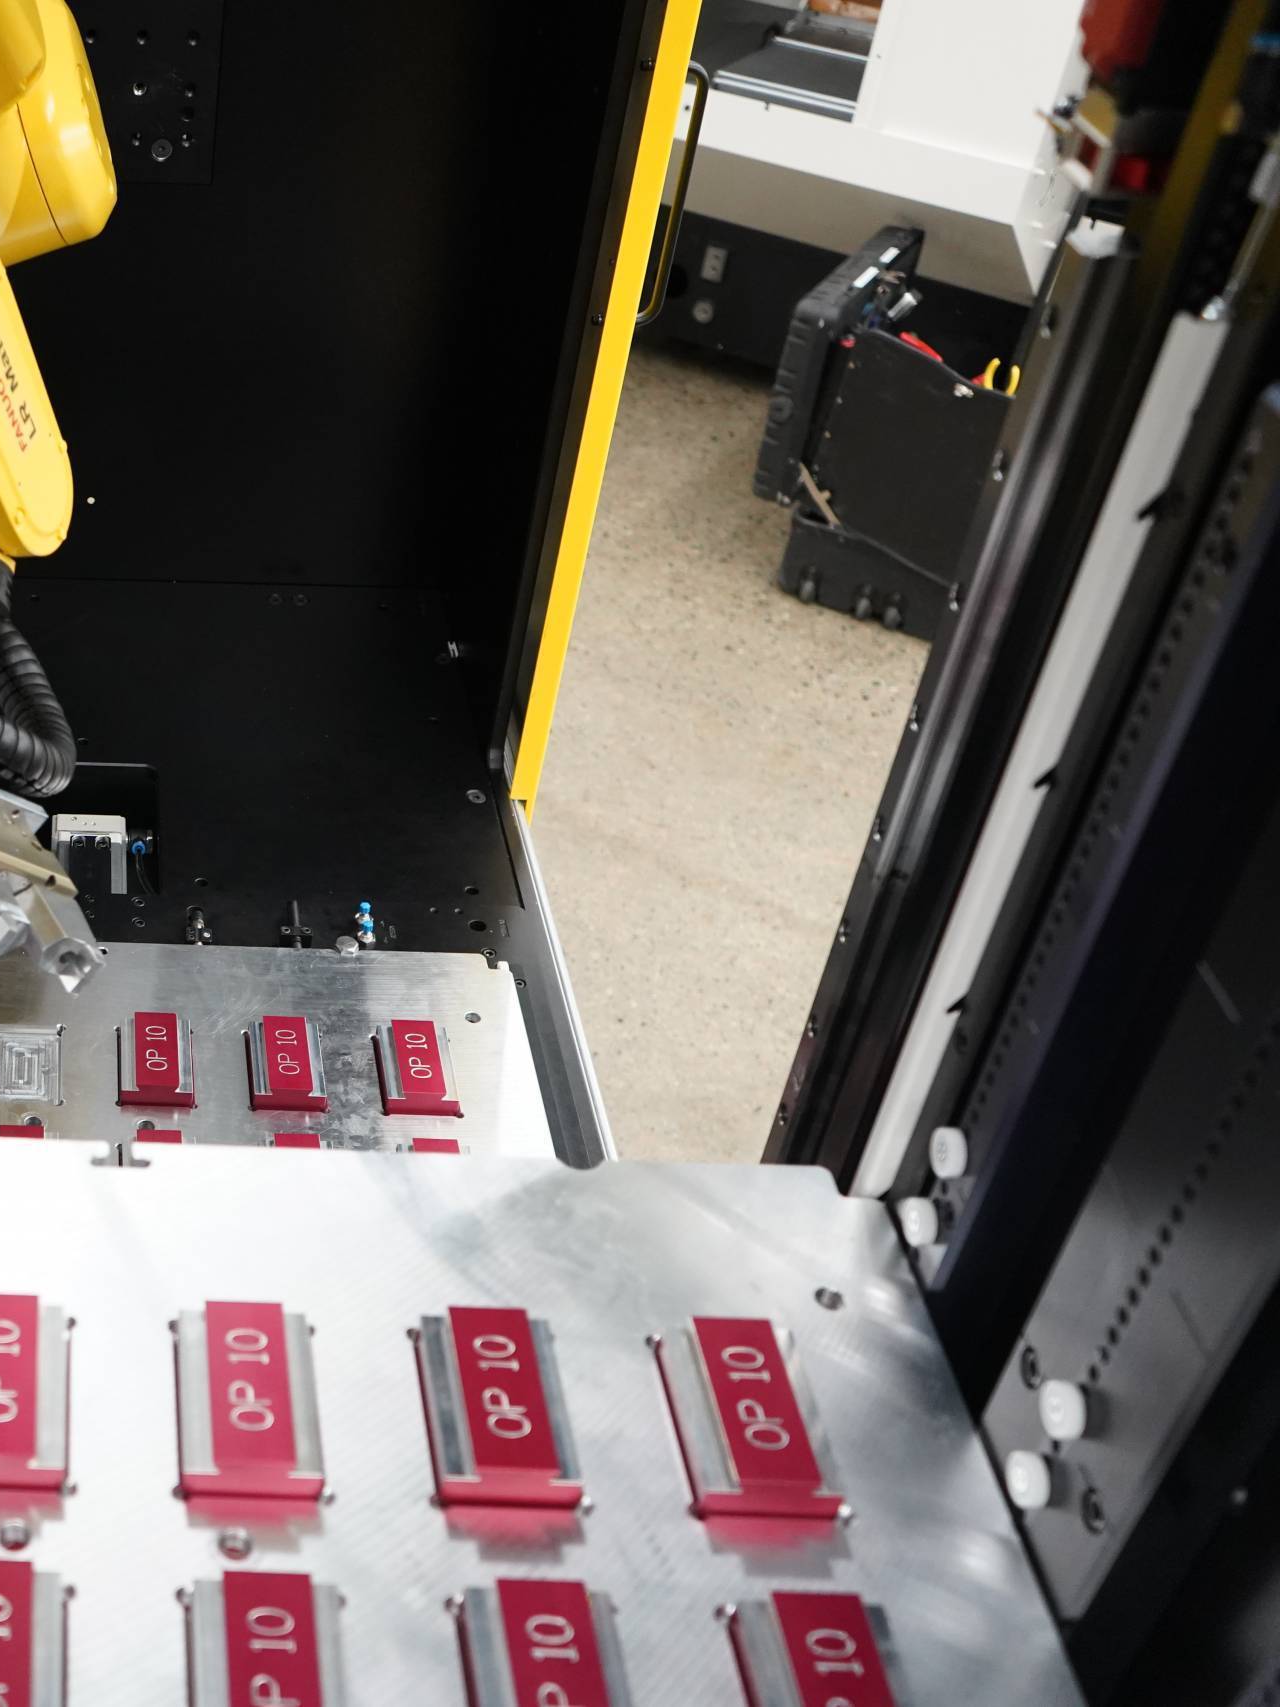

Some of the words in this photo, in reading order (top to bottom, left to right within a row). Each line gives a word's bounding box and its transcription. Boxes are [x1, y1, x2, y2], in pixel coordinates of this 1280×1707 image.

[19, 401, 37, 439] LR
[145, 1025, 167, 1042] 10
[274, 1029, 298, 1046] 10
[404, 1033, 428, 1050] 10
[145, 1048, 168, 1071] OP
[277, 1053, 301, 1075] OP
[408, 1056, 433, 1079] OP
[224, 1327, 270, 1365] 10
[472, 1334, 521, 1372] 10
[720, 1345, 771, 1384] 10
[227, 1379, 275, 1431] OP
[482, 1386, 533, 1440] OP
[736, 1398, 791, 1450] OP
[245, 1606, 298, 1654] 10
[524, 1613, 580, 1664] 10
[805, 1628, 865, 1678] 10
[249, 1673, 301, 1707] P
